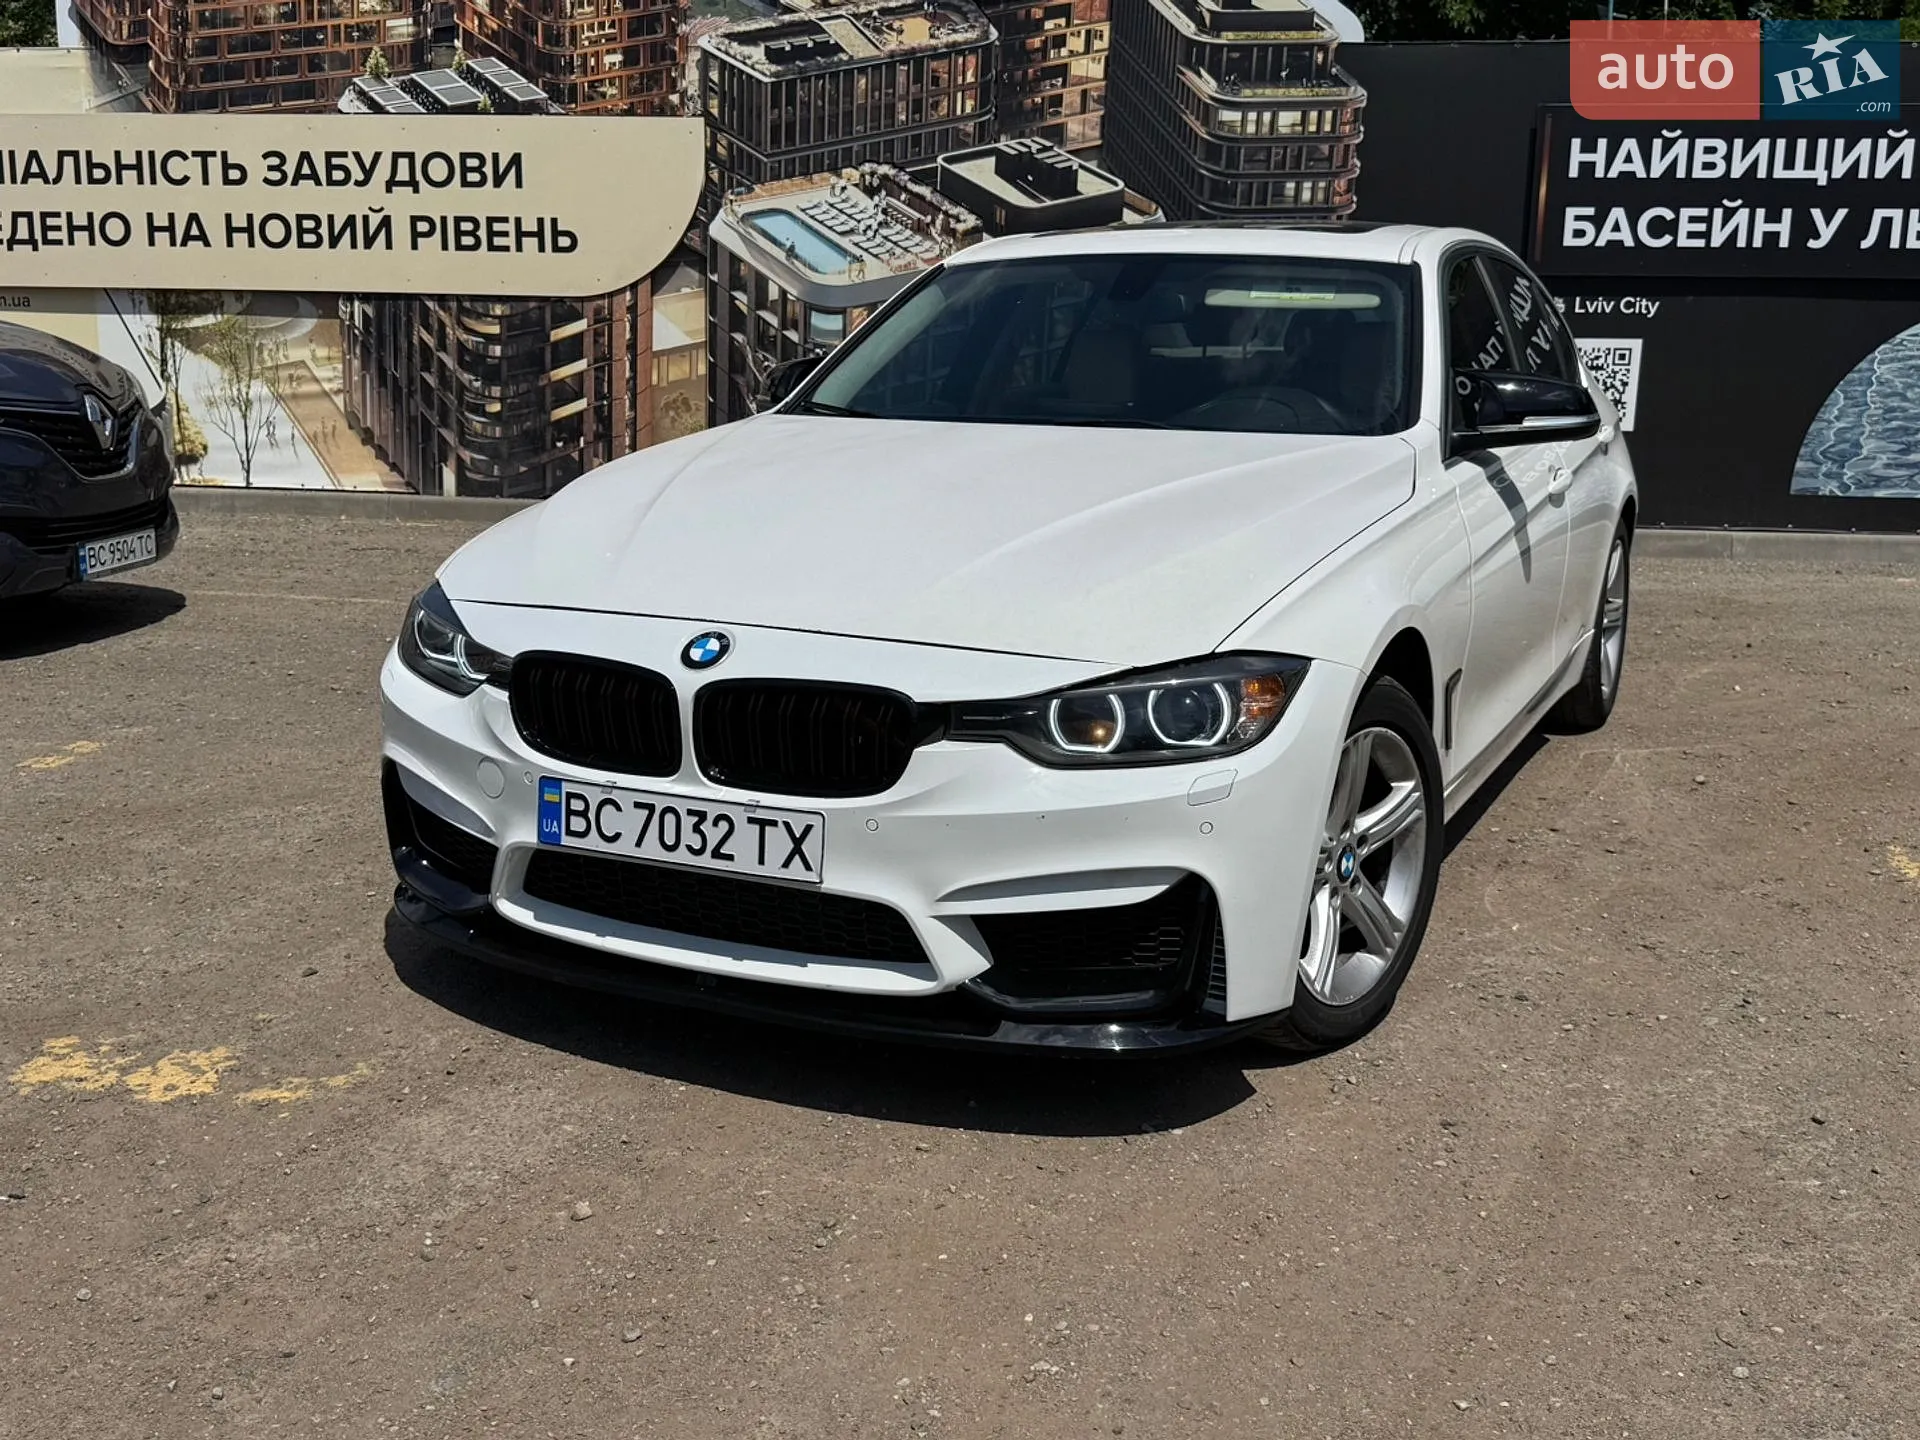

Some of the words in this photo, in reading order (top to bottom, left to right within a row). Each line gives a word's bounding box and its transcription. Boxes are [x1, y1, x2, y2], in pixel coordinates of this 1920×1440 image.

[0, 150, 248, 186] ІАЛЬНІСТЬ
[262, 150, 523, 194] ЗАБУДОВИ
[1568, 129, 1916, 186] НАЙВИЩИЙ
[0, 211, 131, 251] ДЕНО
[146, 212, 212, 247] НА
[224, 205, 393, 250] НОВИЙ
[409, 215, 579, 253] РІВЕНЬ
[1562, 198, 1793, 248] БАСЕЙН
[1806, 208, 1849, 249] У
[1575, 296, 1615, 313] Lviv
[1620, 296, 1660, 318] City
[88, 546, 106, 569] BC
[109, 536, 137, 564] 9504
[137, 534, 153, 557] TC
[543, 818, 560, 834] UA
[565, 790, 623, 843] BC
[633, 801, 735, 863] 7032
[747, 816, 814, 872] TX
